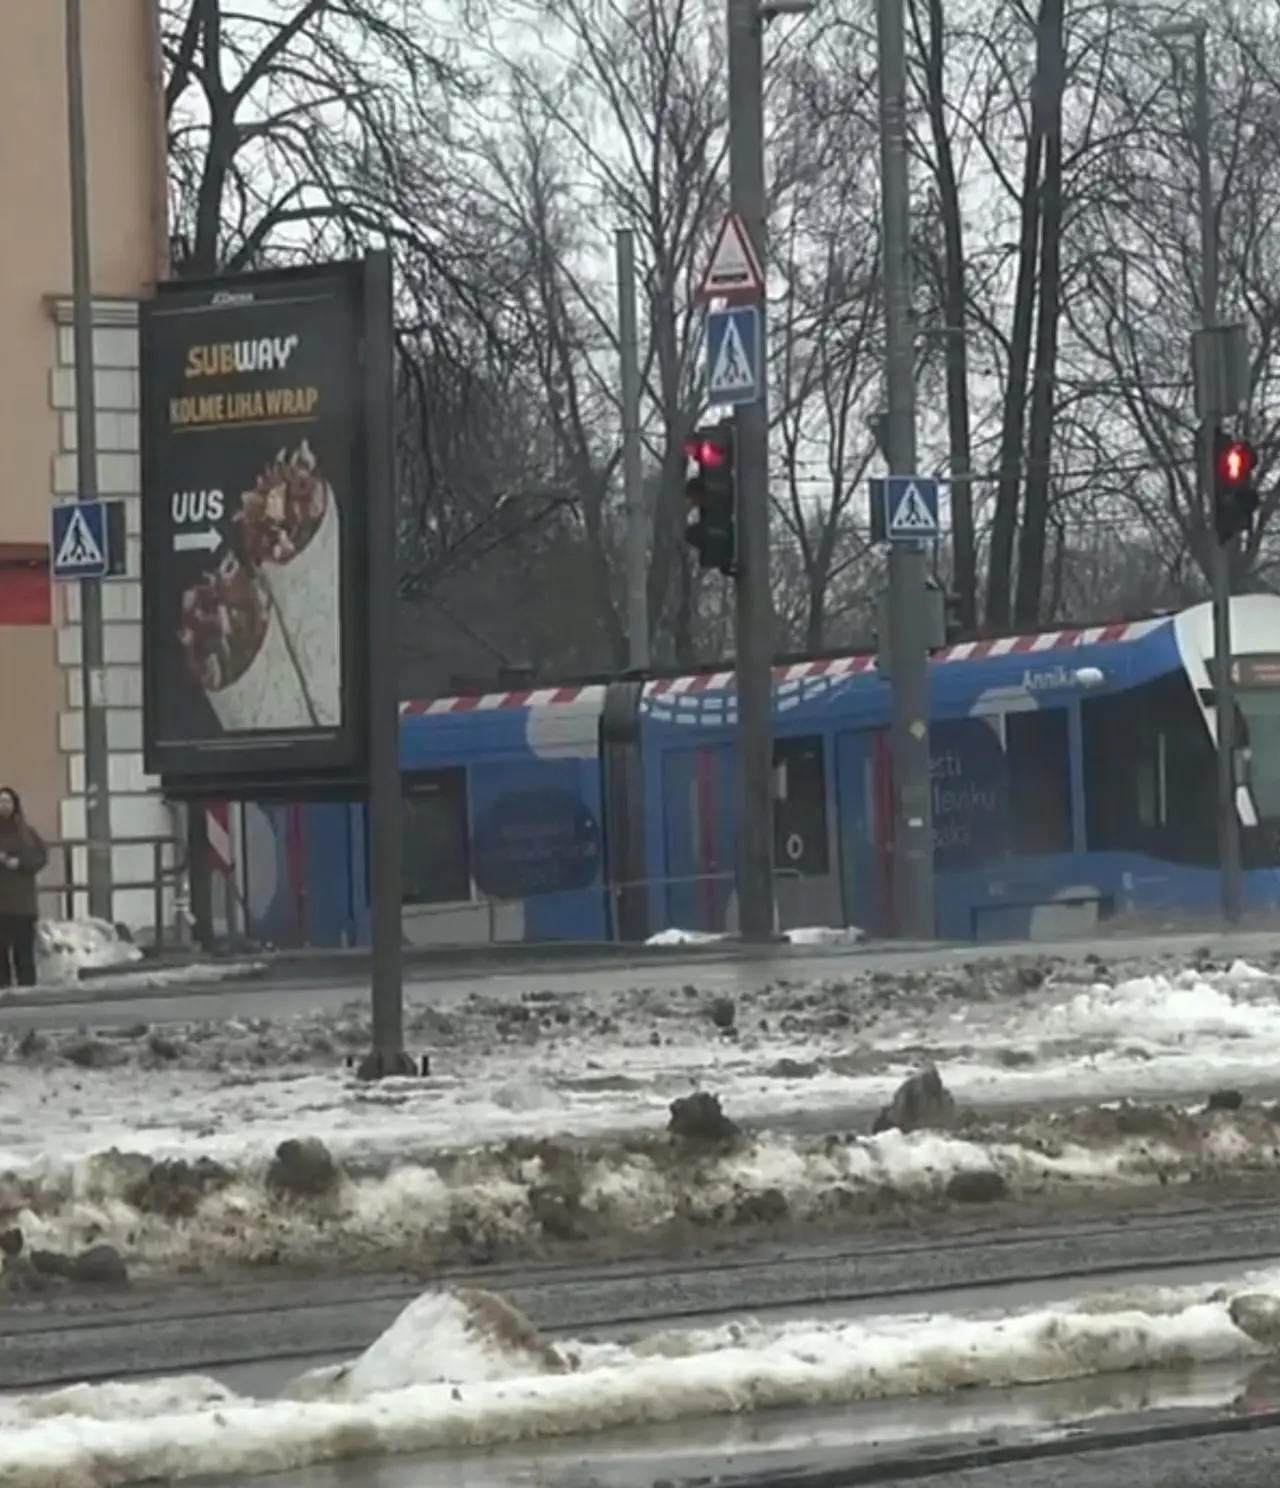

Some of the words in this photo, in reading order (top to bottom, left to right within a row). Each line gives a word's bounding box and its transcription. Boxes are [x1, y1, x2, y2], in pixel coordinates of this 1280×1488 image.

[170, 394, 224, 424] KOLME
[265, 387, 318, 416] WRAP
[172, 489, 225, 524] UUS
